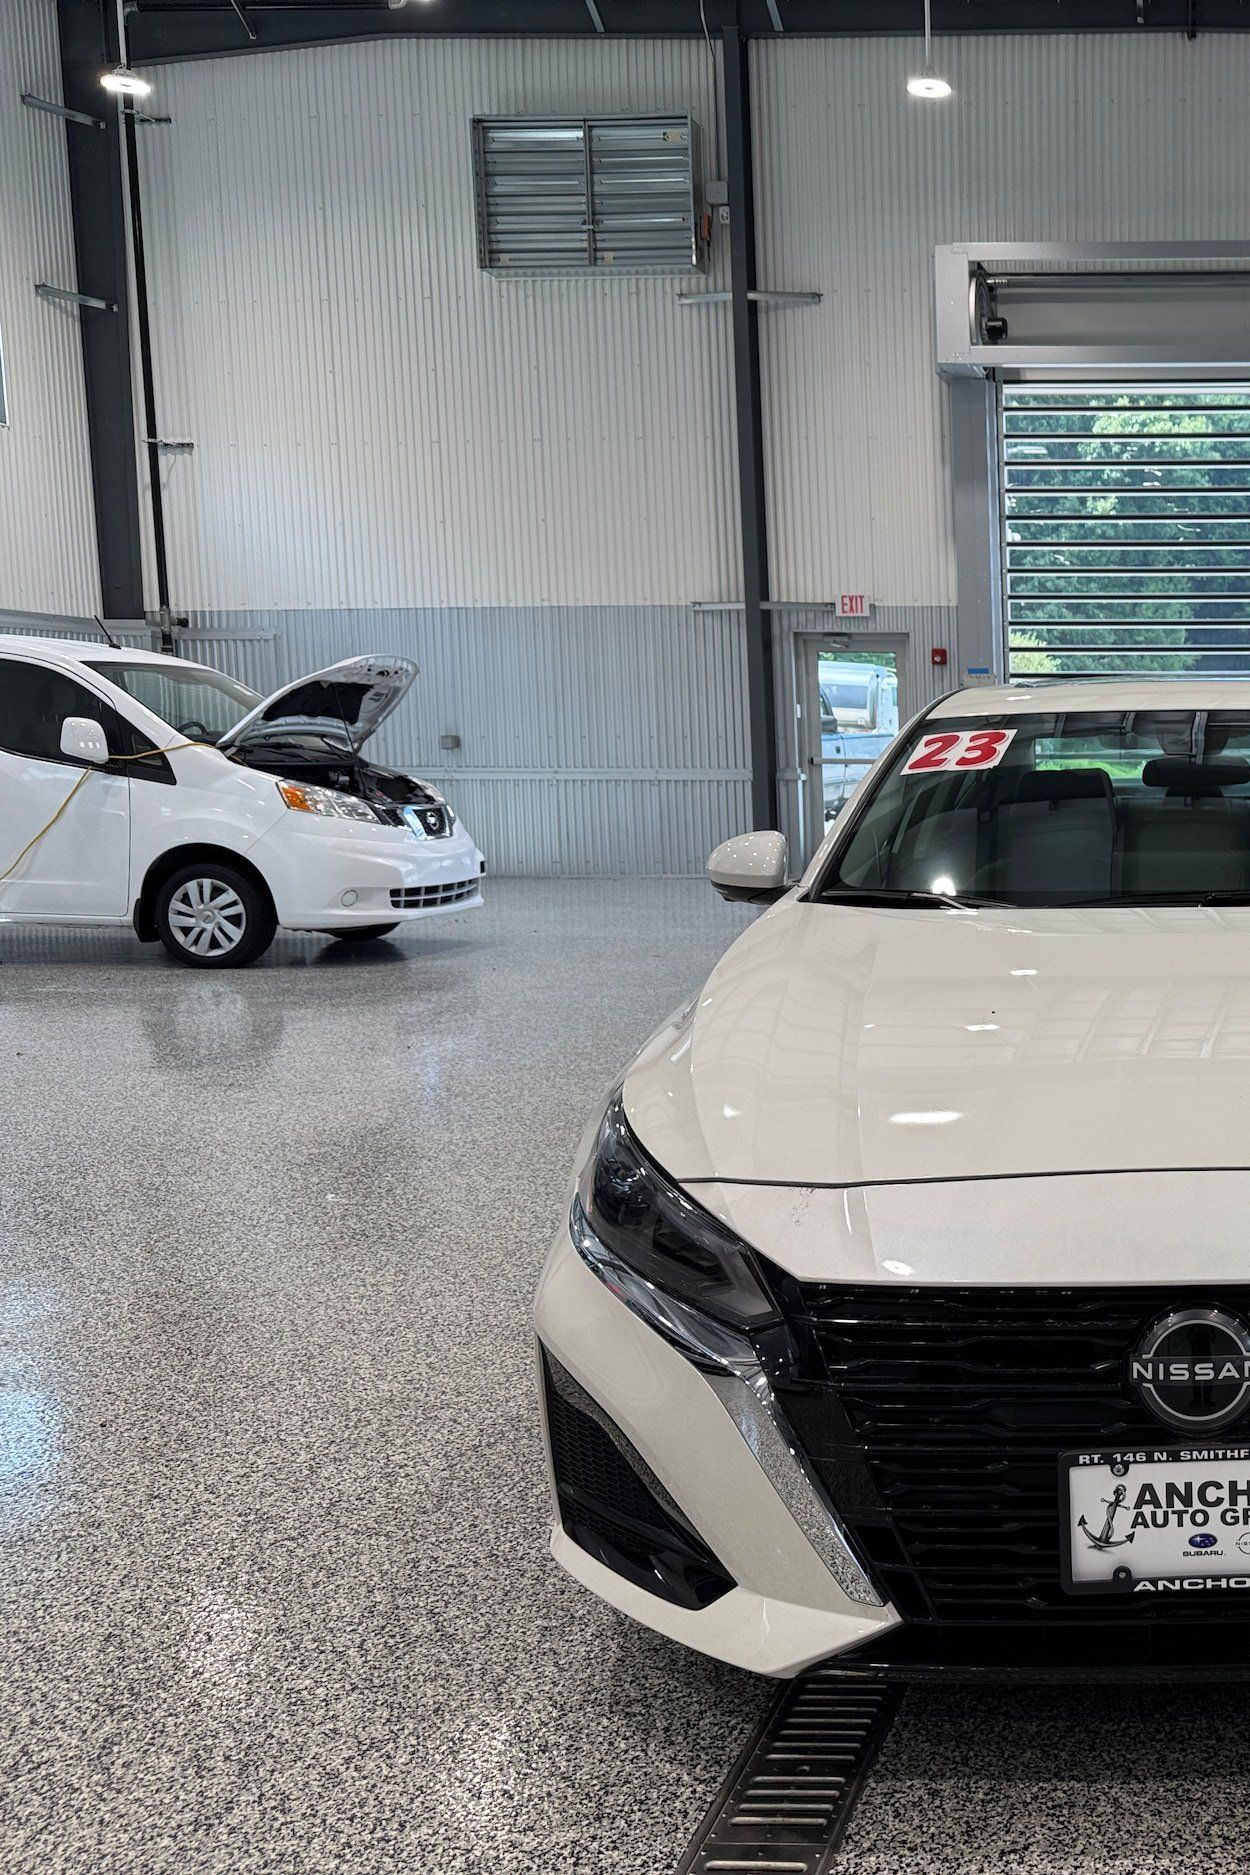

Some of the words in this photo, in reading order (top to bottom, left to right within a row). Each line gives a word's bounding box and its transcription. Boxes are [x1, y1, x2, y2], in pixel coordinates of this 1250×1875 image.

[841, 595, 865, 614] EXIT
[908, 731, 1007, 770] 23
[1078, 1454, 1104, 1465] RT.
[1113, 1452, 1147, 1463] 146
[1153, 1451, 1173, 1461] N.
[1130, 1510, 1210, 1529] AUTO
